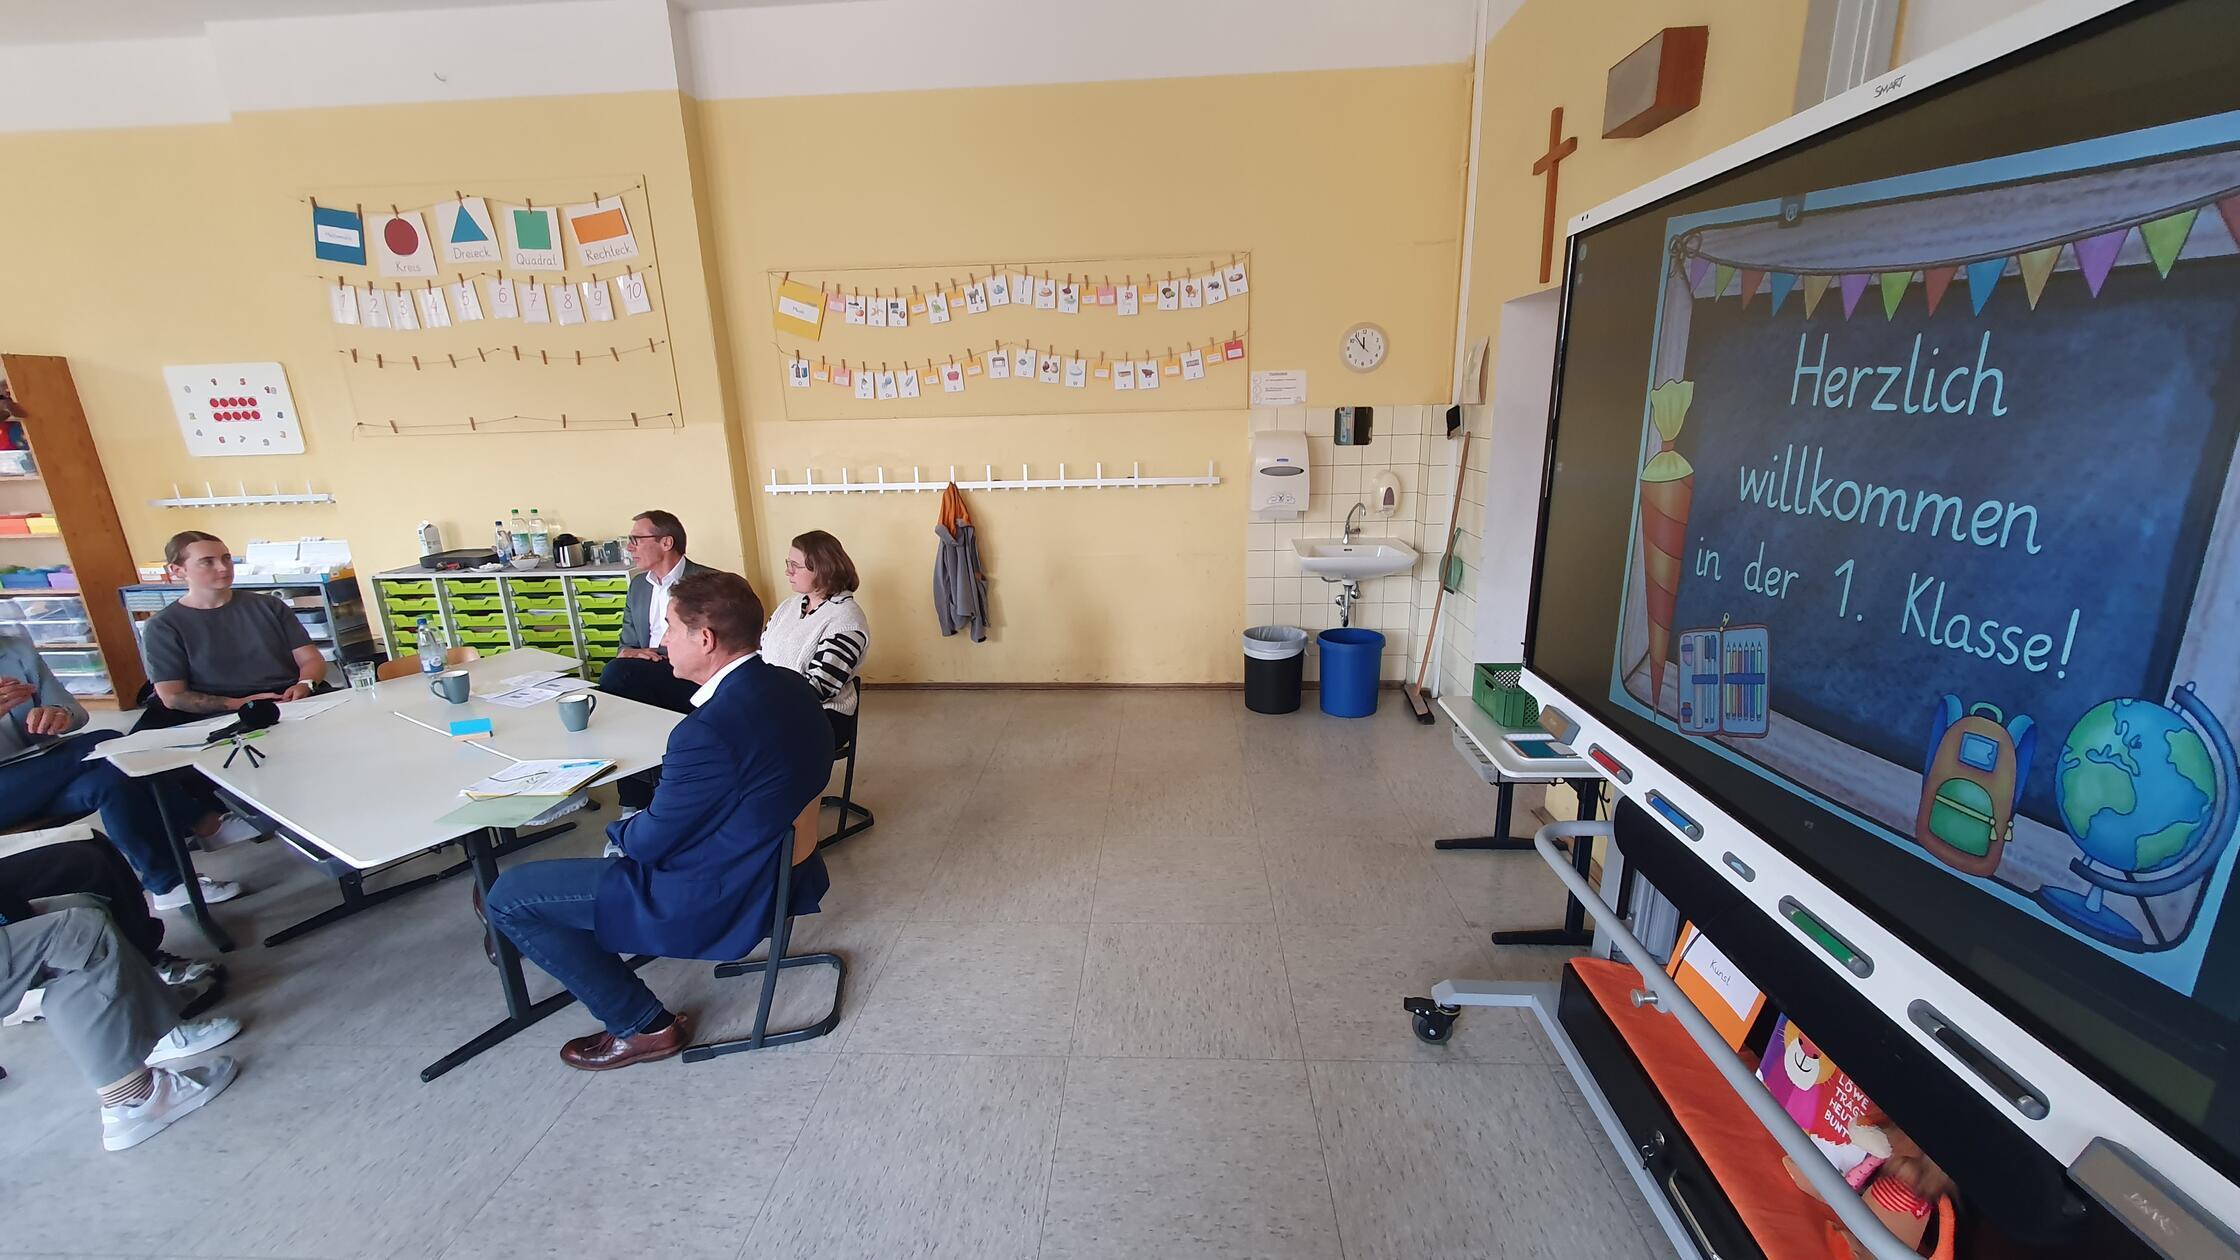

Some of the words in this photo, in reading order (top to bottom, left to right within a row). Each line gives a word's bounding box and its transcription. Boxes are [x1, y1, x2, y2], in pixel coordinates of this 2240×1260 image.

[1874, 74, 1906, 98] SMART
[452, 246, 490, 260] Dreieck
[516, 252, 558, 266] Quadrat
[585, 242, 632, 262] Rechteck
[396, 261, 422, 272] Kreis
[462, 290, 470, 306] 5
[498, 288, 508, 303] 6
[594, 290, 602, 306] 9
[626, 282, 642, 300] 10
[340, 294, 346, 308] 1
[370, 298, 378, 314] 2
[400, 300, 408, 316] 3
[430, 296, 438, 313] 4
[529, 292, 537, 308] 7
[564, 294, 572, 310] 8
[1790, 330, 2008, 417] Herzlich
[239, 378, 246, 386] 5
[1739, 444, 2042, 554] willkommen
[1695, 536, 1722, 582] in
[1744, 542, 1800, 599] der
[1834, 558, 1864, 622] 1.
[1900, 572, 2080, 680] Klasse!
[1709, 959, 1732, 986] Kunst
[1838, 1074, 1869, 1110] LÖWE
[1824, 1109, 1850, 1138] BUNT
